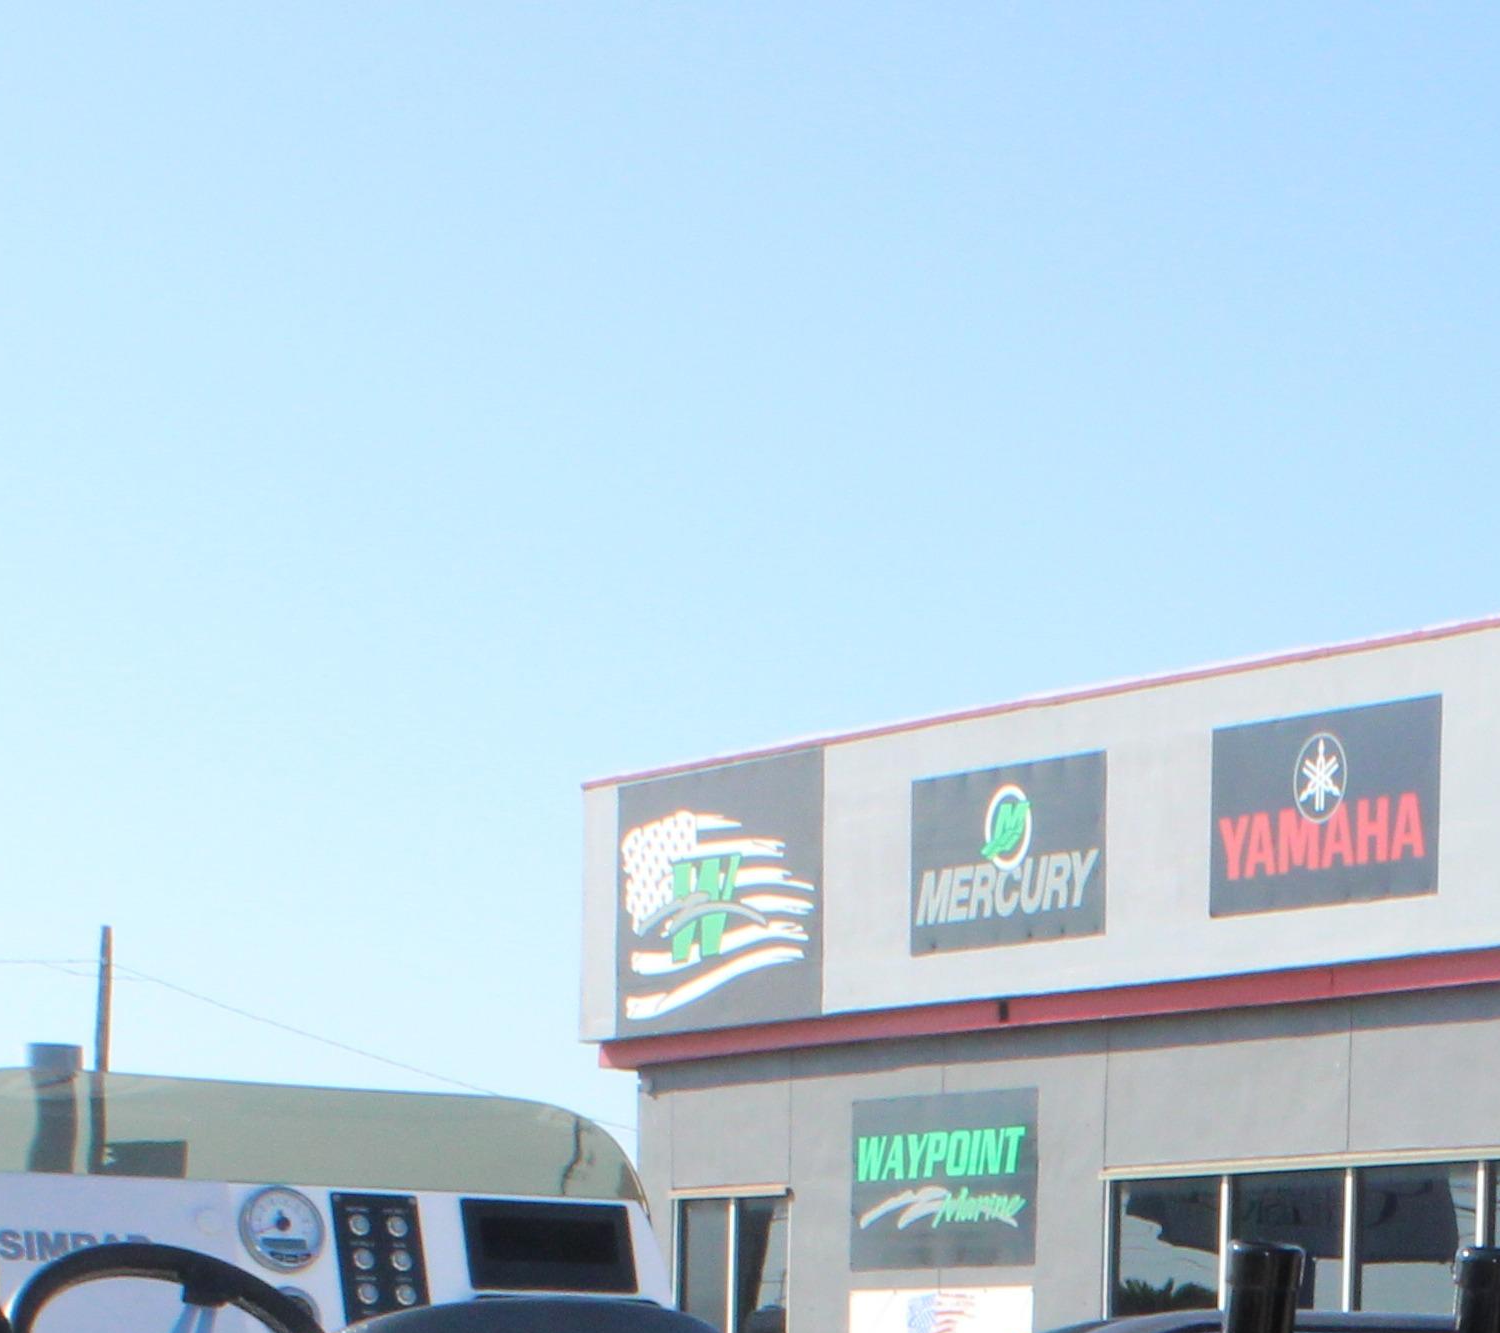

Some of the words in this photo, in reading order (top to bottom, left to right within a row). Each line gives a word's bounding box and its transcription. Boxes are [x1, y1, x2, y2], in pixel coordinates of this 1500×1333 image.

[1217, 791, 1426, 881] YAMAHA
[915, 847, 1099, 926] MERCURY
[856, 1125, 1026, 1183] WAYPOINT
[931, 1187, 1027, 1230] Marine
